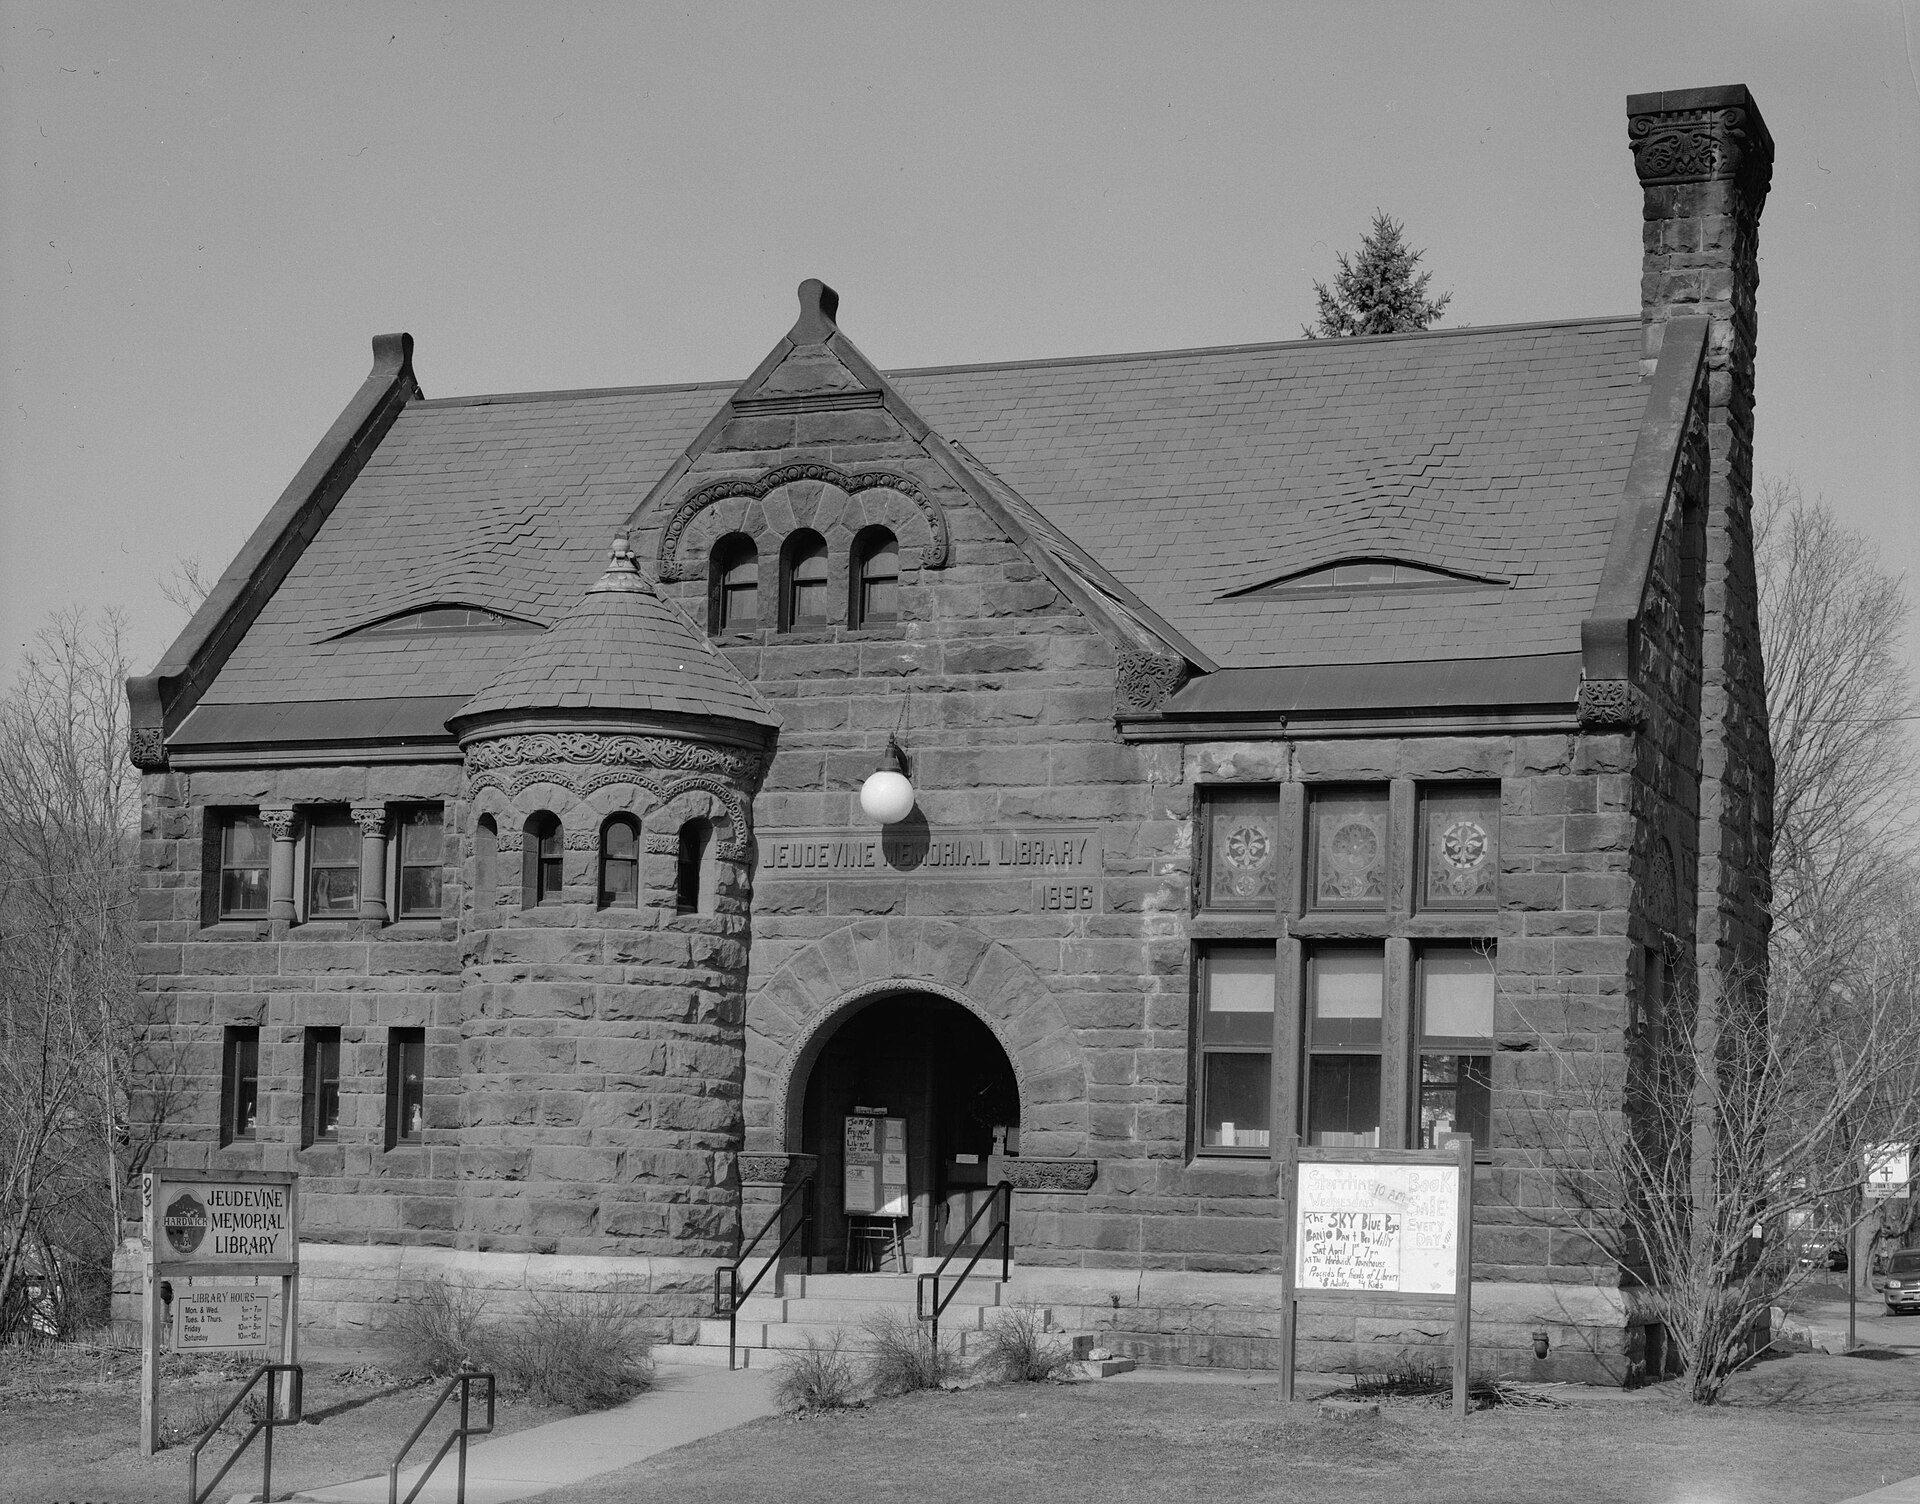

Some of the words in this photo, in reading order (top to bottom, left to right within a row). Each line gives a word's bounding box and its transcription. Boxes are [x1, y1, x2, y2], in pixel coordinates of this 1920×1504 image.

[763, 840, 876, 869] JEUDEVINE
[883, 839, 990, 868] MEMORIAL
[998, 838, 1088, 867] LIBRARY
[1039, 884, 1094, 911] 1896
[143, 1177, 152, 1207] 93
[207, 1188, 283, 1210] JEUDEVINE
[1374, 1183, 1386, 1197] 10
[1387, 1189, 1406, 1202] AM
[163, 1216, 208, 1226] HARDWICK
[210, 1212, 284, 1232] MEMORIAL
[1327, 1213, 1357, 1229] SKY
[215, 1233, 279, 1256] LIBRARY
[1311, 1243, 1327, 1255] Sat
[1327, 1242, 1347, 1258] April
[1324, 1255, 1352, 1266] Hardwick
[1367, 1269, 1376, 1279] of
[1375, 1268, 1400, 1282] Library
[1329, 1277, 1350, 1287] Adults
[1367, 1279, 1384, 1290] Kids
[191, 1292, 228, 1303] LIBRARY
[230, 1292, 255, 1302] HOURS
[184, 1324, 201, 1333] Friday
[183, 1334, 208, 1342] Saturday
